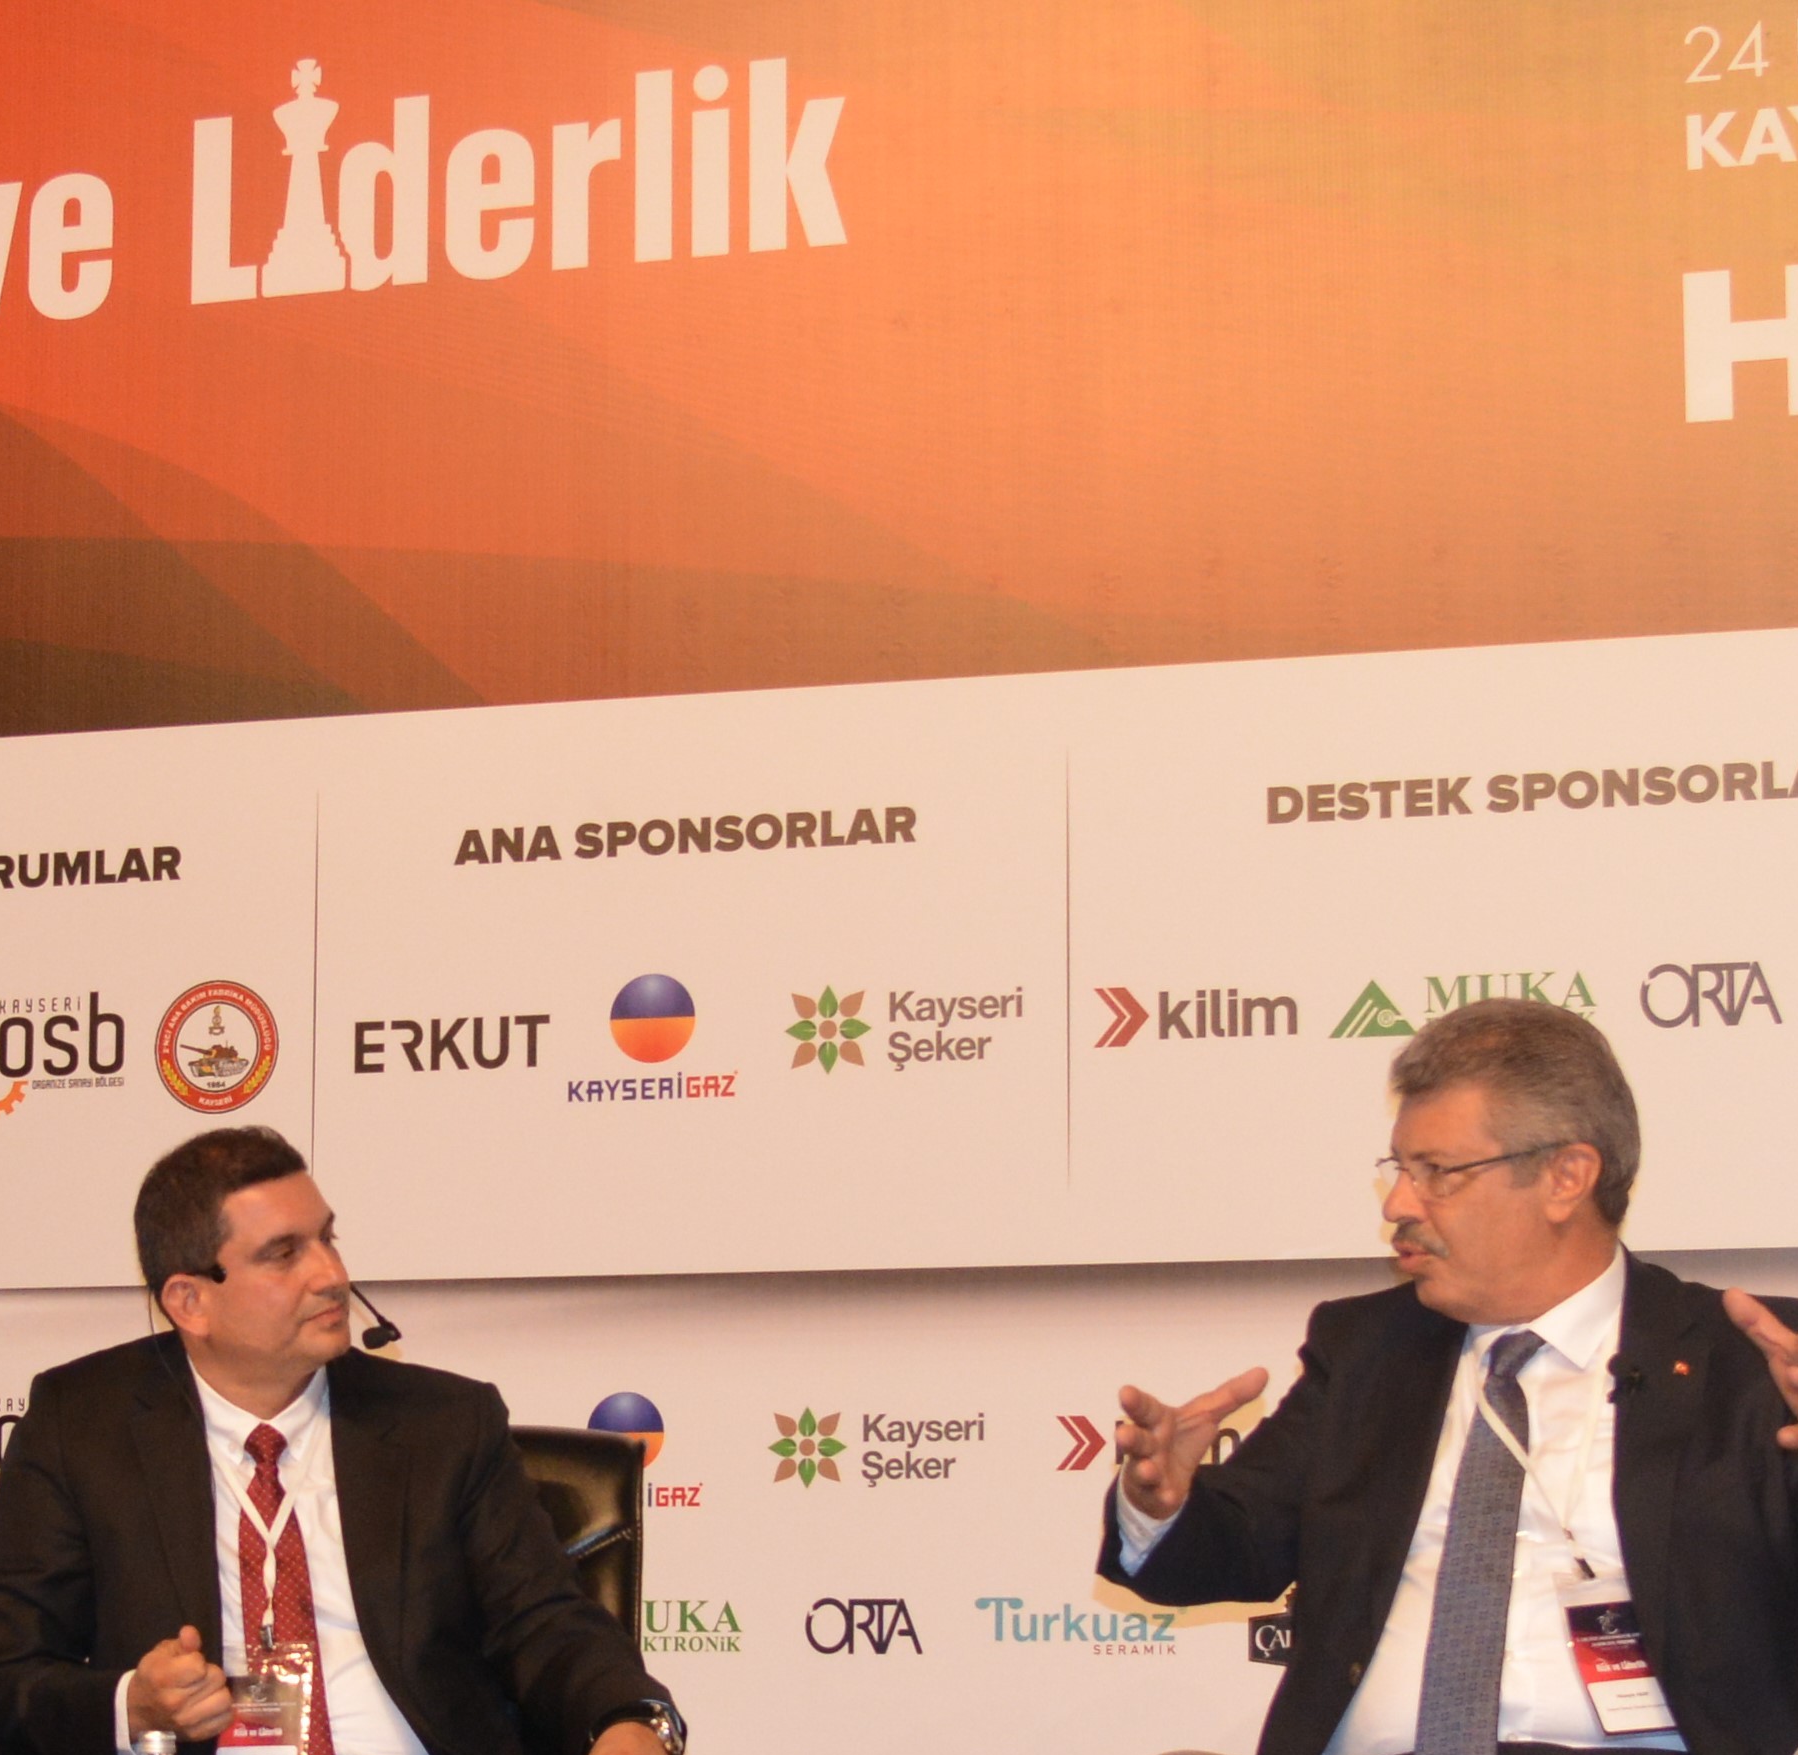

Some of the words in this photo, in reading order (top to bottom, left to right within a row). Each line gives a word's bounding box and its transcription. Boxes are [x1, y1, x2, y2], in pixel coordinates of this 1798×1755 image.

[1684, 20, 1769, 83] 24
[1266, 775, 1472, 824] DESTEK
[454, 825, 561, 866] ANA
[573, 806, 916, 859] SPONSORLAR
[888, 987, 1023, 1026] Kayseri
[1158, 988, 1298, 1040] kilim
[1424, 970, 1597, 1013] MUKA
[1640, 961, 1782, 1028] ORTA
[353, 1014, 550, 1073] ERKUT
[888, 1031, 991, 1071] Şeker
[862, 1412, 985, 1449] Kayseri
[862, 1452, 956, 1488] Şeker
[644, 1600, 742, 1633] UKA
[805, 1597, 923, 1655] ORTA
[975, 1597, 1175, 1642] Turkuaz
[643, 1636, 741, 1652] KTRONiK
